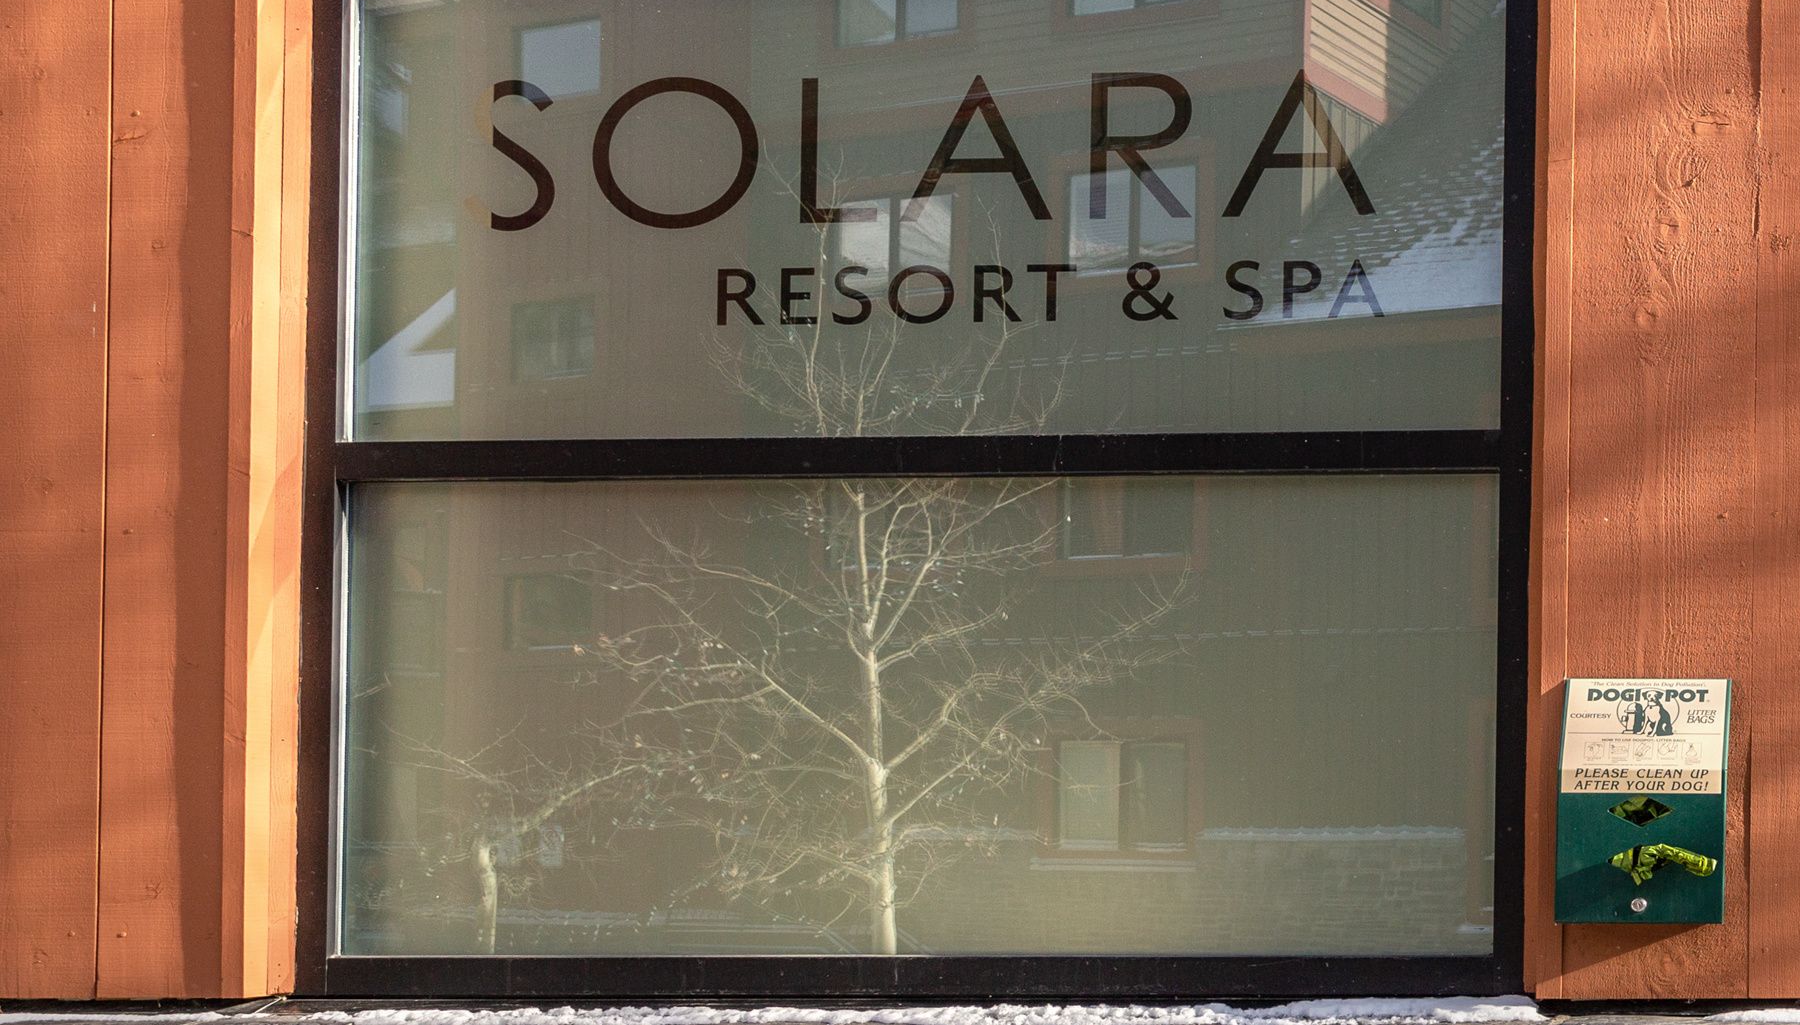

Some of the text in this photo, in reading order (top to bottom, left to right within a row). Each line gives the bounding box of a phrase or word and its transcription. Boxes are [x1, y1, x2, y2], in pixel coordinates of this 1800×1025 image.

[464, 69, 1377, 232] SOLARA
[715, 258, 1386, 326] RESORT & SPA
[1686, 715, 1715, 724] BAGS
[1574, 768, 1709, 779] PLEASE CLEAN UP
[1574, 780, 1709, 792] AFTER YOUR DOG!
